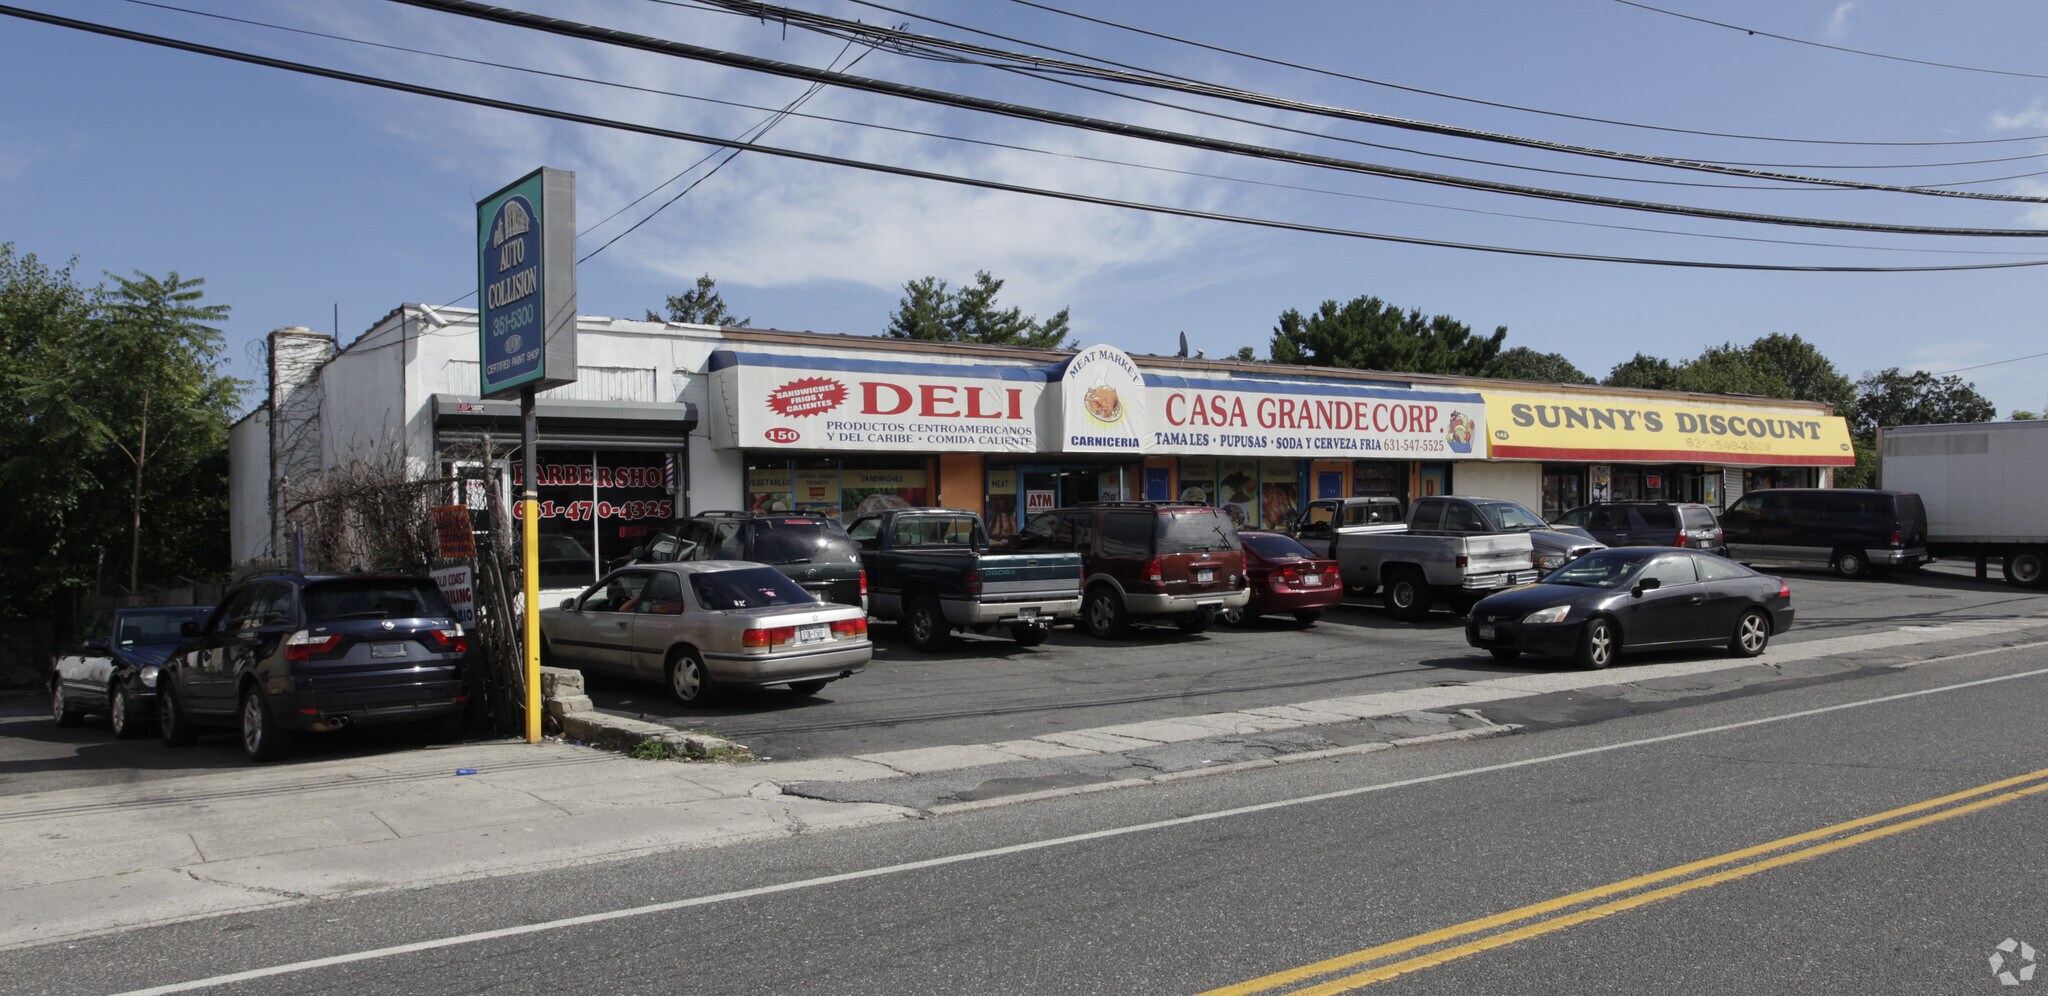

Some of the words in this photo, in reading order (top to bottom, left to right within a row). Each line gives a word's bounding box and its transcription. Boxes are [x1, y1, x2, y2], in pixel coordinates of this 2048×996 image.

[499, 237, 525, 272] AUTO
[488, 265, 538, 310] COLLISION
[493, 303, 534, 337] 351-5300
[487, 360, 511, 375] CERTIFIED
[511, 353, 526, 367] PAINT
[526, 347, 540, 361] SHOP
[1069, 351, 1096, 379] MEAT
[1099, 350, 1140, 382] MARKET
[776, 384, 836, 399] SANDWICHES
[790, 394, 817, 405] FRIOS
[786, 400, 832, 412] CALIENTES
[859, 381, 1023, 419] DELI
[1165, 393, 1248, 428] CASA
[1257, 397, 1369, 431] GRANDE
[1372, 403, 1444, 434] CORP.
[1511, 403, 1664, 432] SUNNY'S
[1675, 412, 1821, 440] DISCOUNT
[769, 430, 798, 440] 150
[826, 420, 905, 433] PRODUCTOS
[908, 423, 1032, 436] CENTROAMERICANOS
[826, 433, 835, 442] Y
[839, 433, 864, 442] DEL
[867, 434, 914, 443] CARIBE
[927, 435, 976, 445] COMIDA
[979, 437, 1032, 446] CALIENTE
[1071, 435, 1140, 448] CARNICERIA
[1155, 432, 1209, 446] TAMALES
[1220, 434, 1268, 448] PUPUSAS
[1276, 437, 1303, 449] SODA
[1306, 437, 1313, 449] Y
[1314, 437, 1358, 450] CERVEZA
[1360, 438, 1382, 450] FRIA
[1384, 439, 1445, 452] 631-547-5525
[513, 464, 612, 488] BARBER
[860, 474, 904, 483] SANDWICHES
[991, 480, 1009, 488] MEAT
[1029, 494, 1052, 507] ATM
[448, 572, 466, 586] COAST
